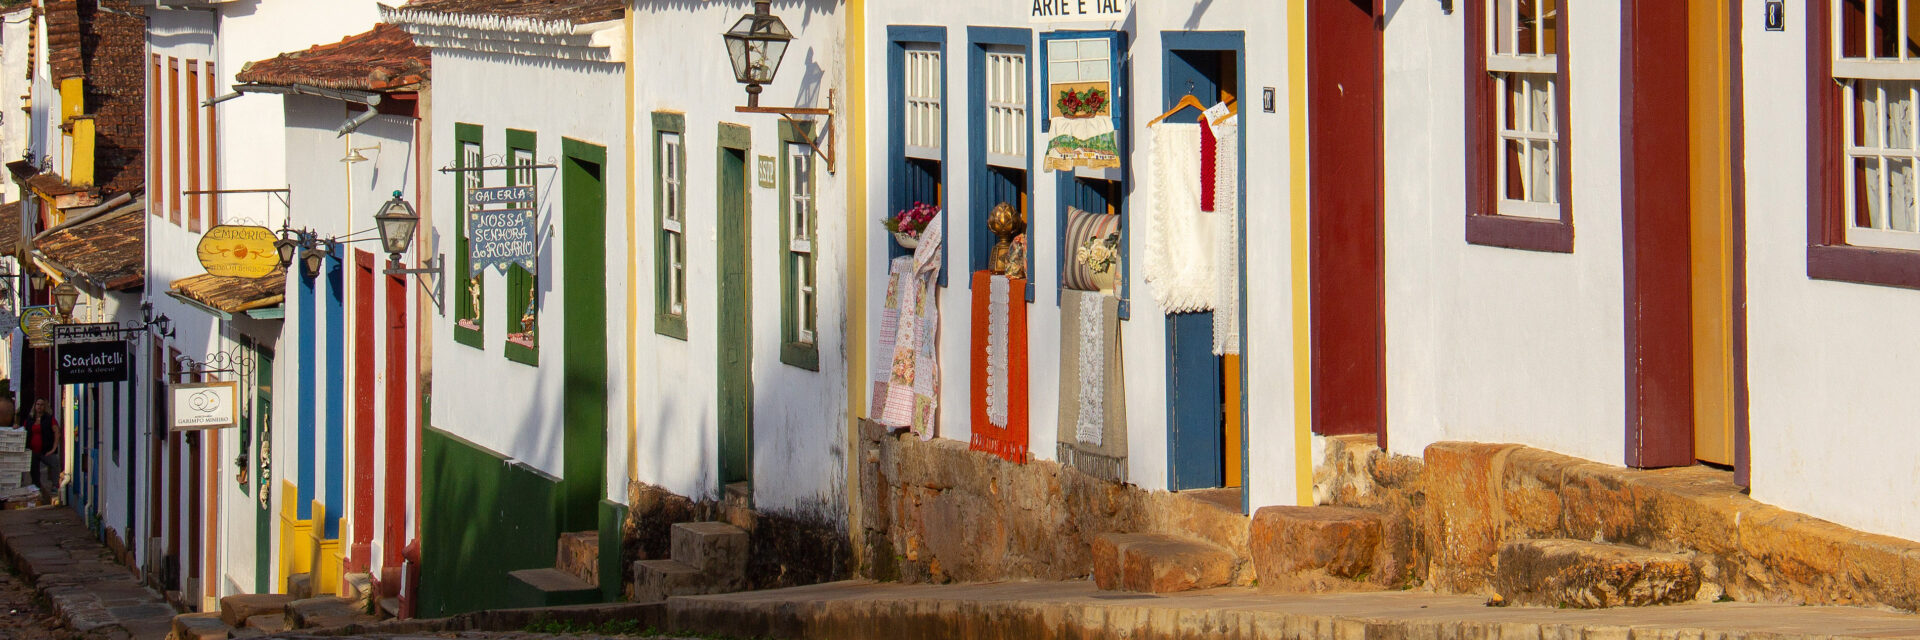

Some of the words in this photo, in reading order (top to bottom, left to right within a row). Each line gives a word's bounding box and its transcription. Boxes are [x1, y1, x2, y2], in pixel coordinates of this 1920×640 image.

[1032, 0, 1070, 17] ARTE
[1079, 0, 1087, 15] E
[1097, 0, 1122, 14] TAL
[1769, 4, 1775, 25] 8
[475, 188, 526, 202] GALERIA
[477, 213, 524, 228] NOSSA
[213, 228, 267, 240] EMPÓRIO
[475, 227, 528, 243] SENHORA
[472, 243, 487, 258] do
[62, 352, 123, 367] Scarlatelli
